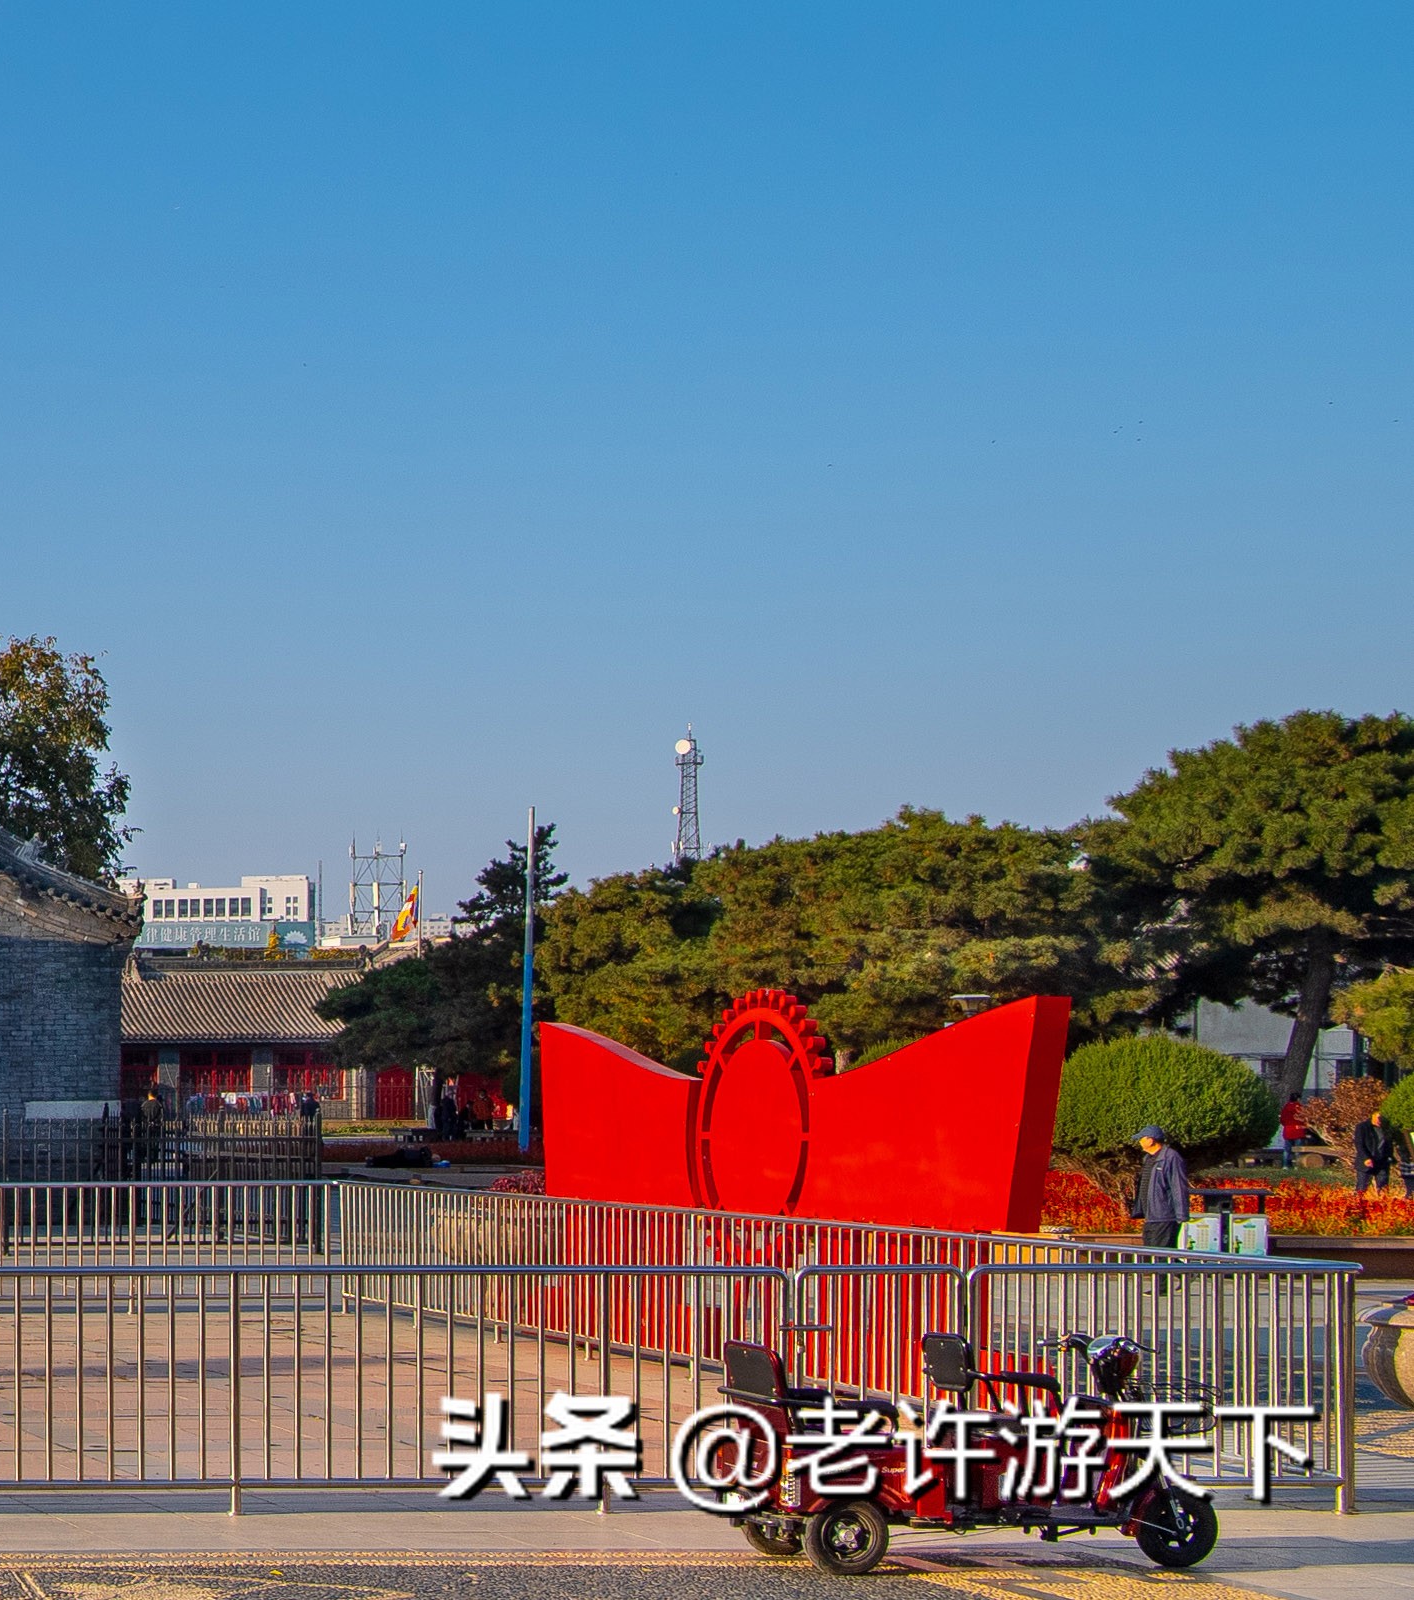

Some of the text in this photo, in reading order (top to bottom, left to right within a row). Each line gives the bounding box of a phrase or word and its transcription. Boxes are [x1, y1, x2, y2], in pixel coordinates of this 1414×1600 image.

[138, 926, 261, 942] 律健康管理生活馆
